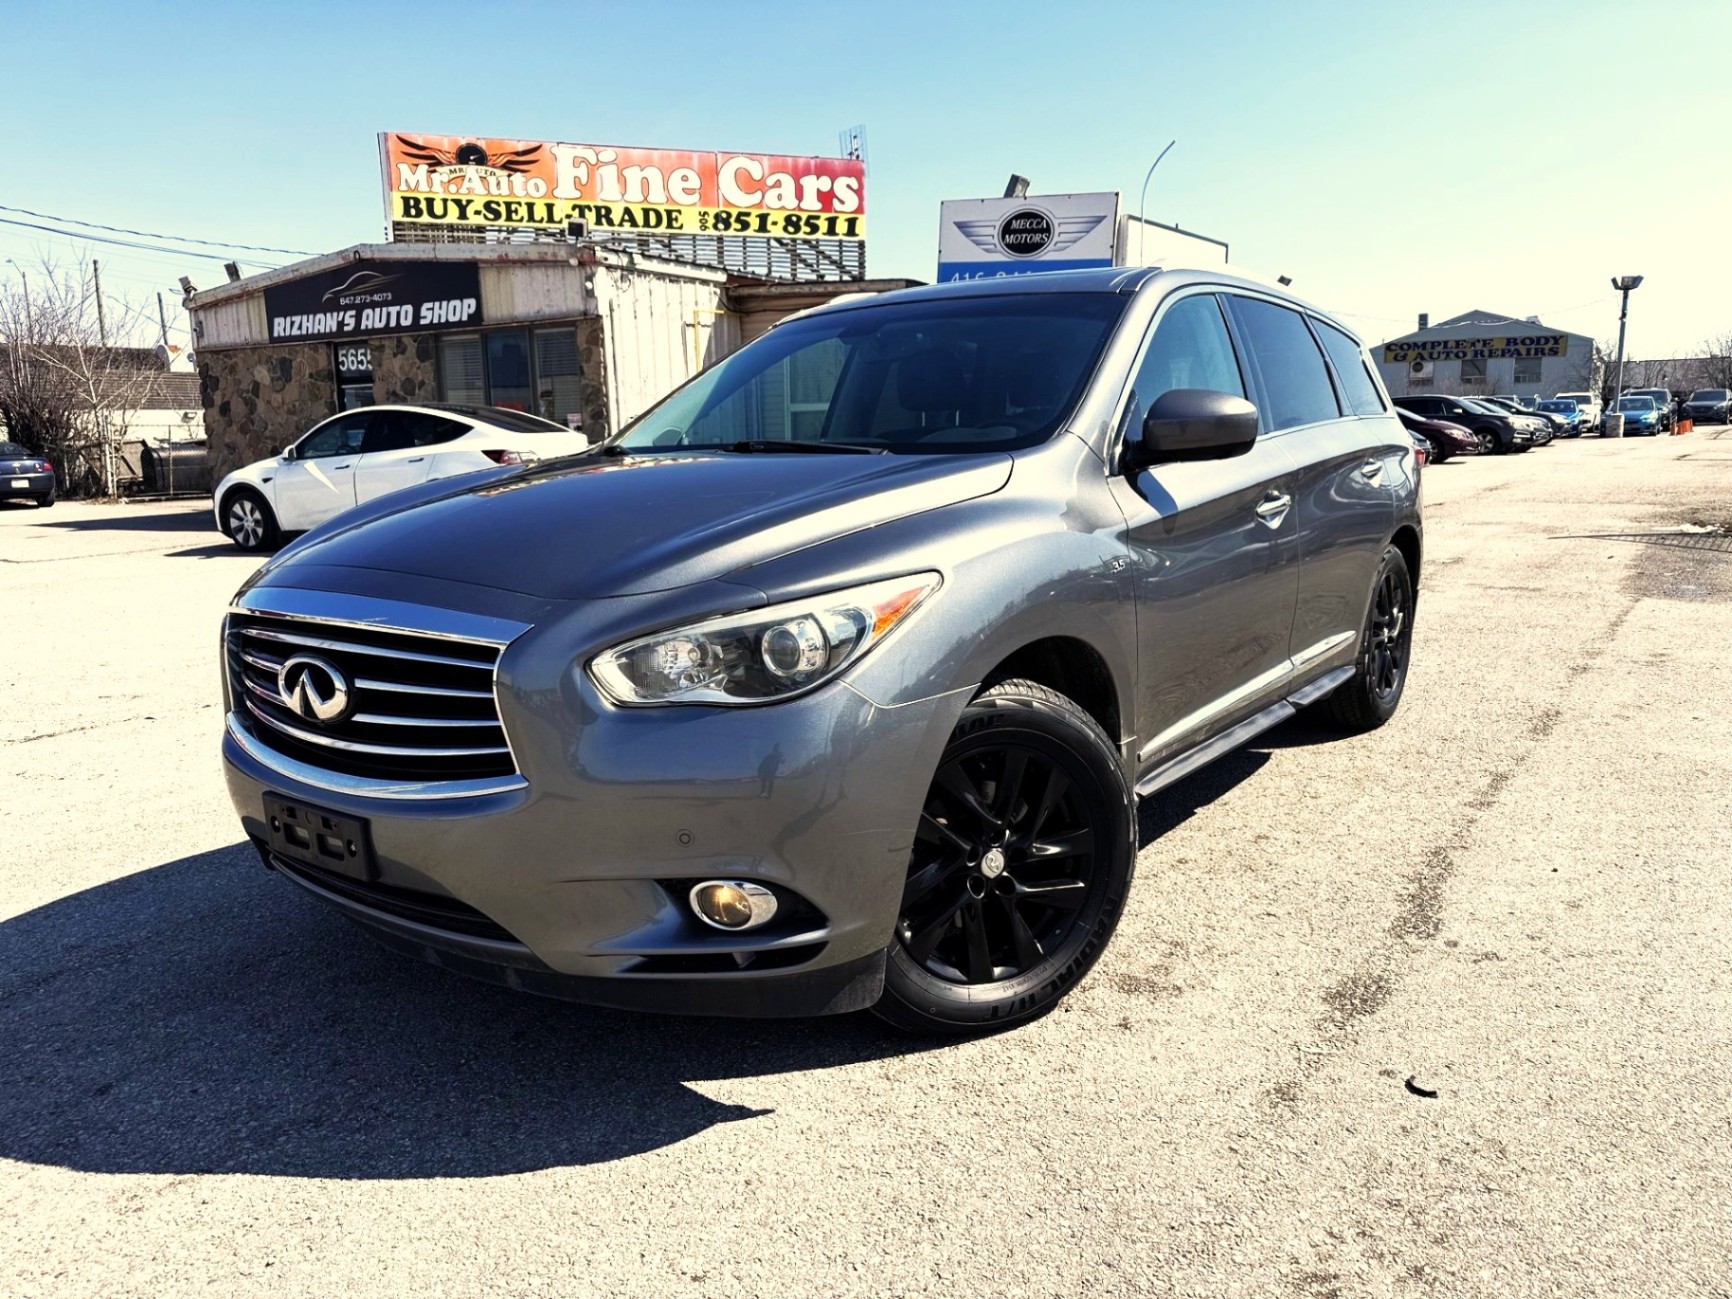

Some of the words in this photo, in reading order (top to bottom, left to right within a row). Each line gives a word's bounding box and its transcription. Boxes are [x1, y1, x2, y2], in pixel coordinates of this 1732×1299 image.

[550, 145, 702, 206] Fine
[717, 155, 859, 213] Cars
[698, 210, 710, 231] 905
[712, 209, 859, 237] 851-8511
[1010, 218, 1047, 230] MECCA
[1004, 232, 1049, 244] MOTORS
[273, 310, 356, 338] RIZHAN'S
[361, 304, 413, 330] AUTO
[419, 298, 477, 325] SHOP
[1386, 338, 1494, 352] COMPLETE
[1505, 335, 1565, 347] BODY
[1393, 351, 1408, 362] &
[1412, 349, 1467, 361] AUTO
[1472, 346, 1560, 358] REPAIRS
